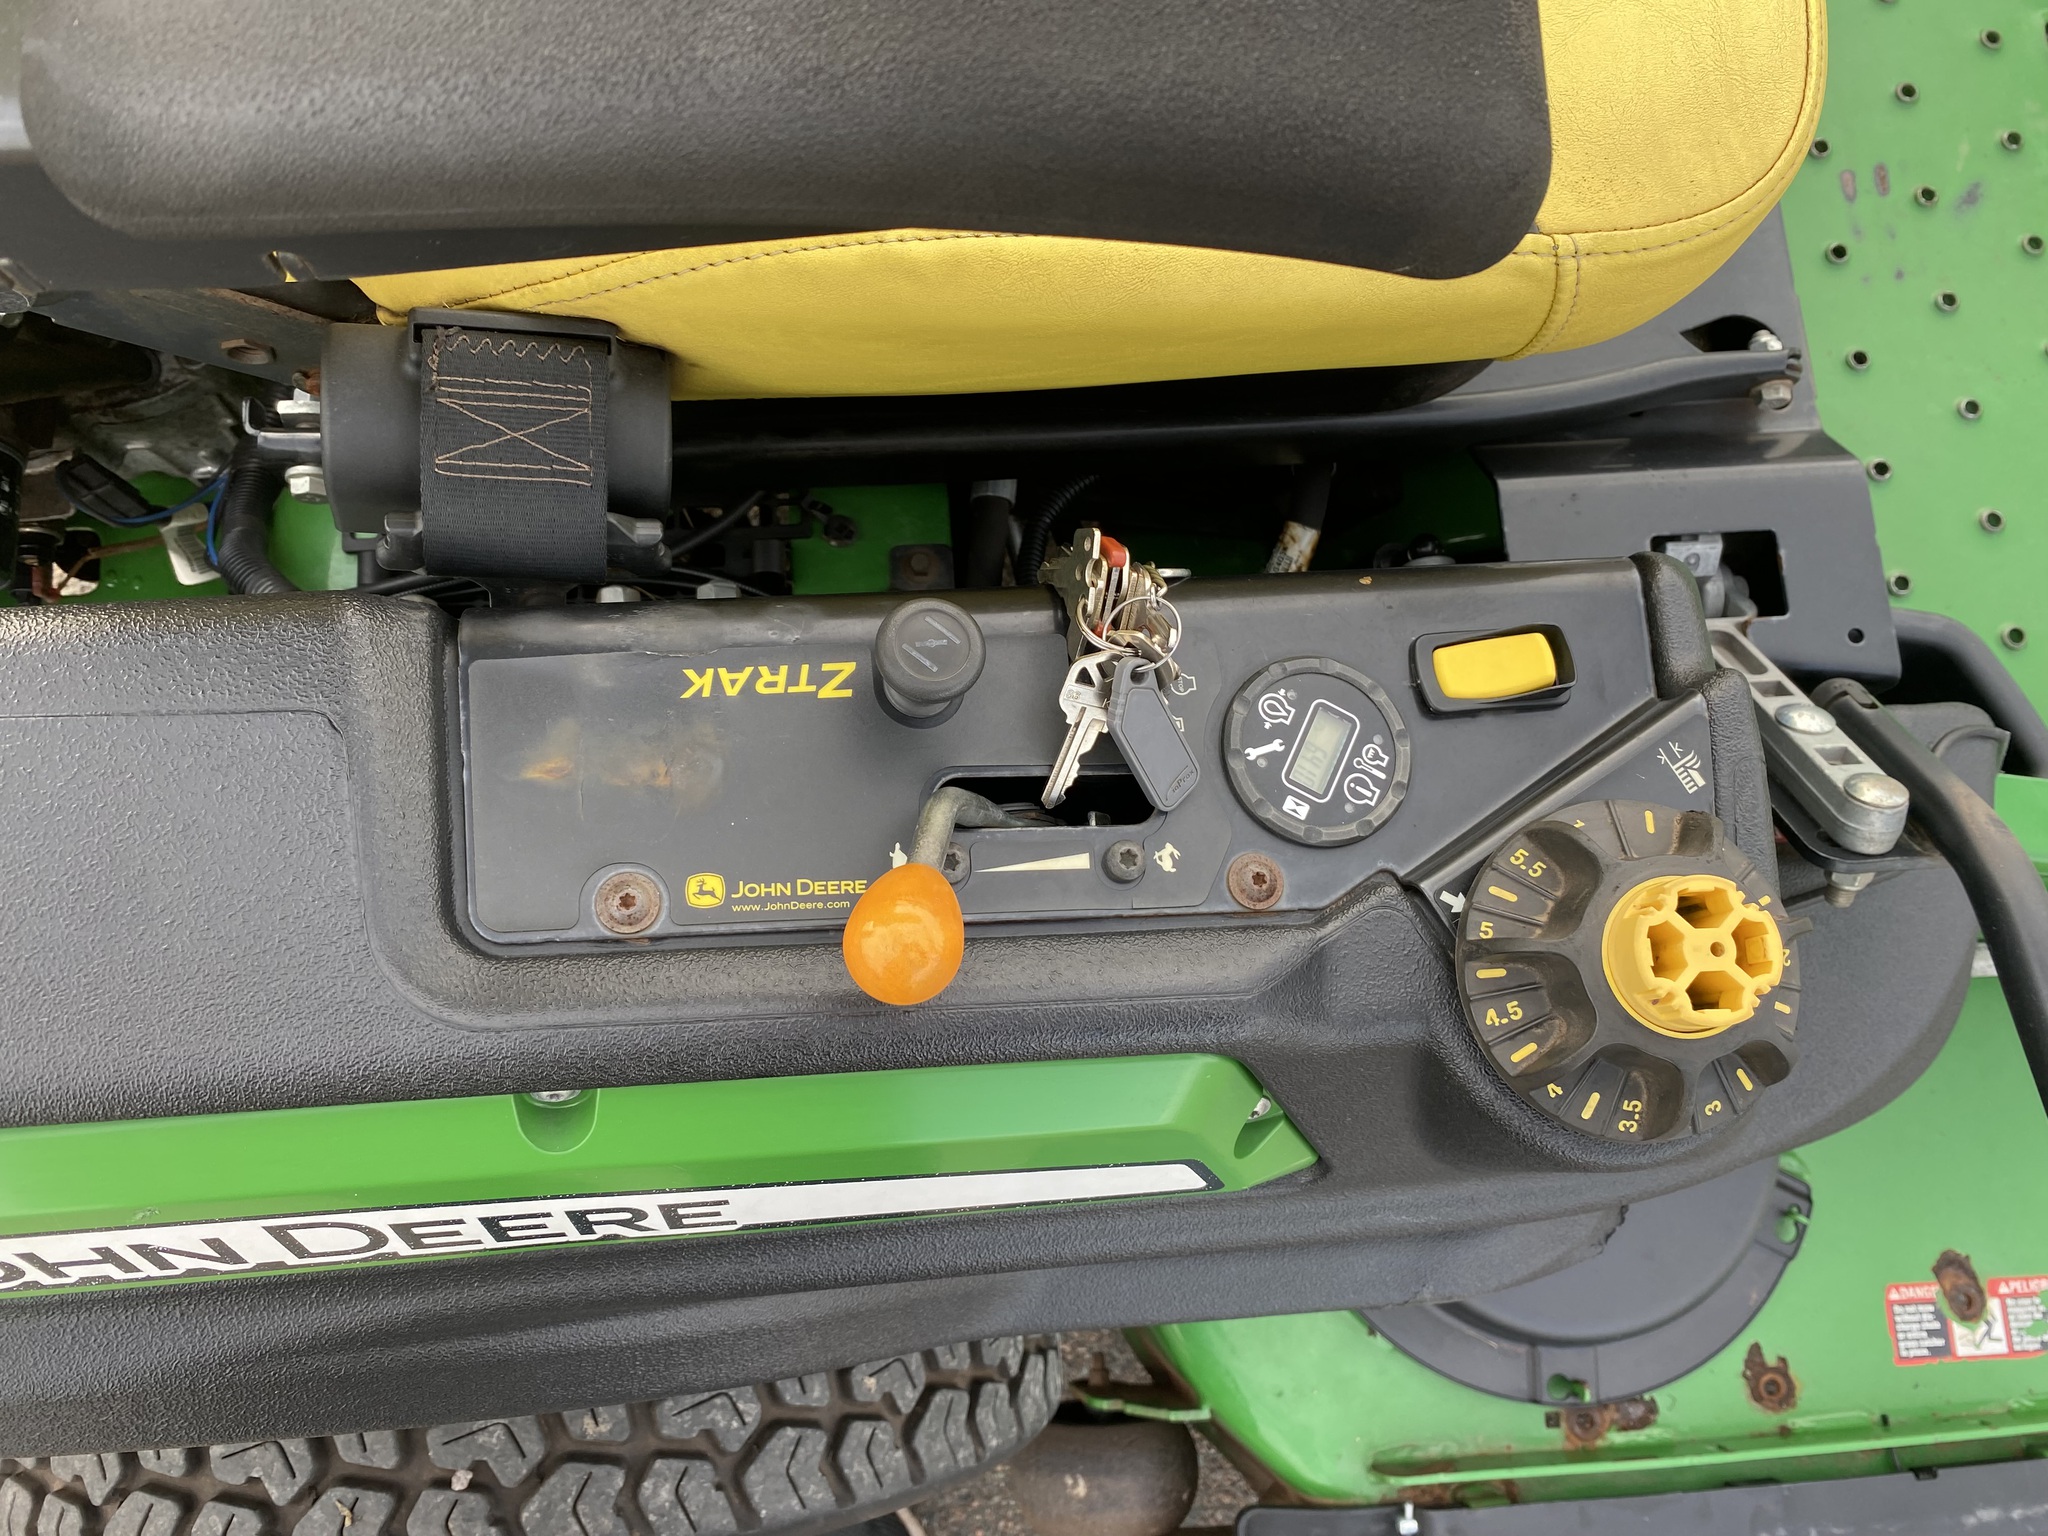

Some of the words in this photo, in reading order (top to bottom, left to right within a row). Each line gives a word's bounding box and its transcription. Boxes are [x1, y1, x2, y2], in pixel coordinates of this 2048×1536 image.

[680, 661, 857, 699] ZTRAK
[1509, 847, 1547, 878] 5.5
[732, 880, 791, 898] JOHN
[796, 878, 868, 897] DEERE
[732, 901, 850, 912] www.JohnDeere.com
[1479, 921, 1495, 939] 5
[1485, 1001, 1523, 1027] 4.5
[1546, 1082, 1563, 1098] 4
[1617, 1099, 1642, 1133] 3.5
[1704, 1099, 1722, 1117] 3
[261, 1199, 738, 1259] DEERE
[1900, 1284, 1939, 1300] DANGE
